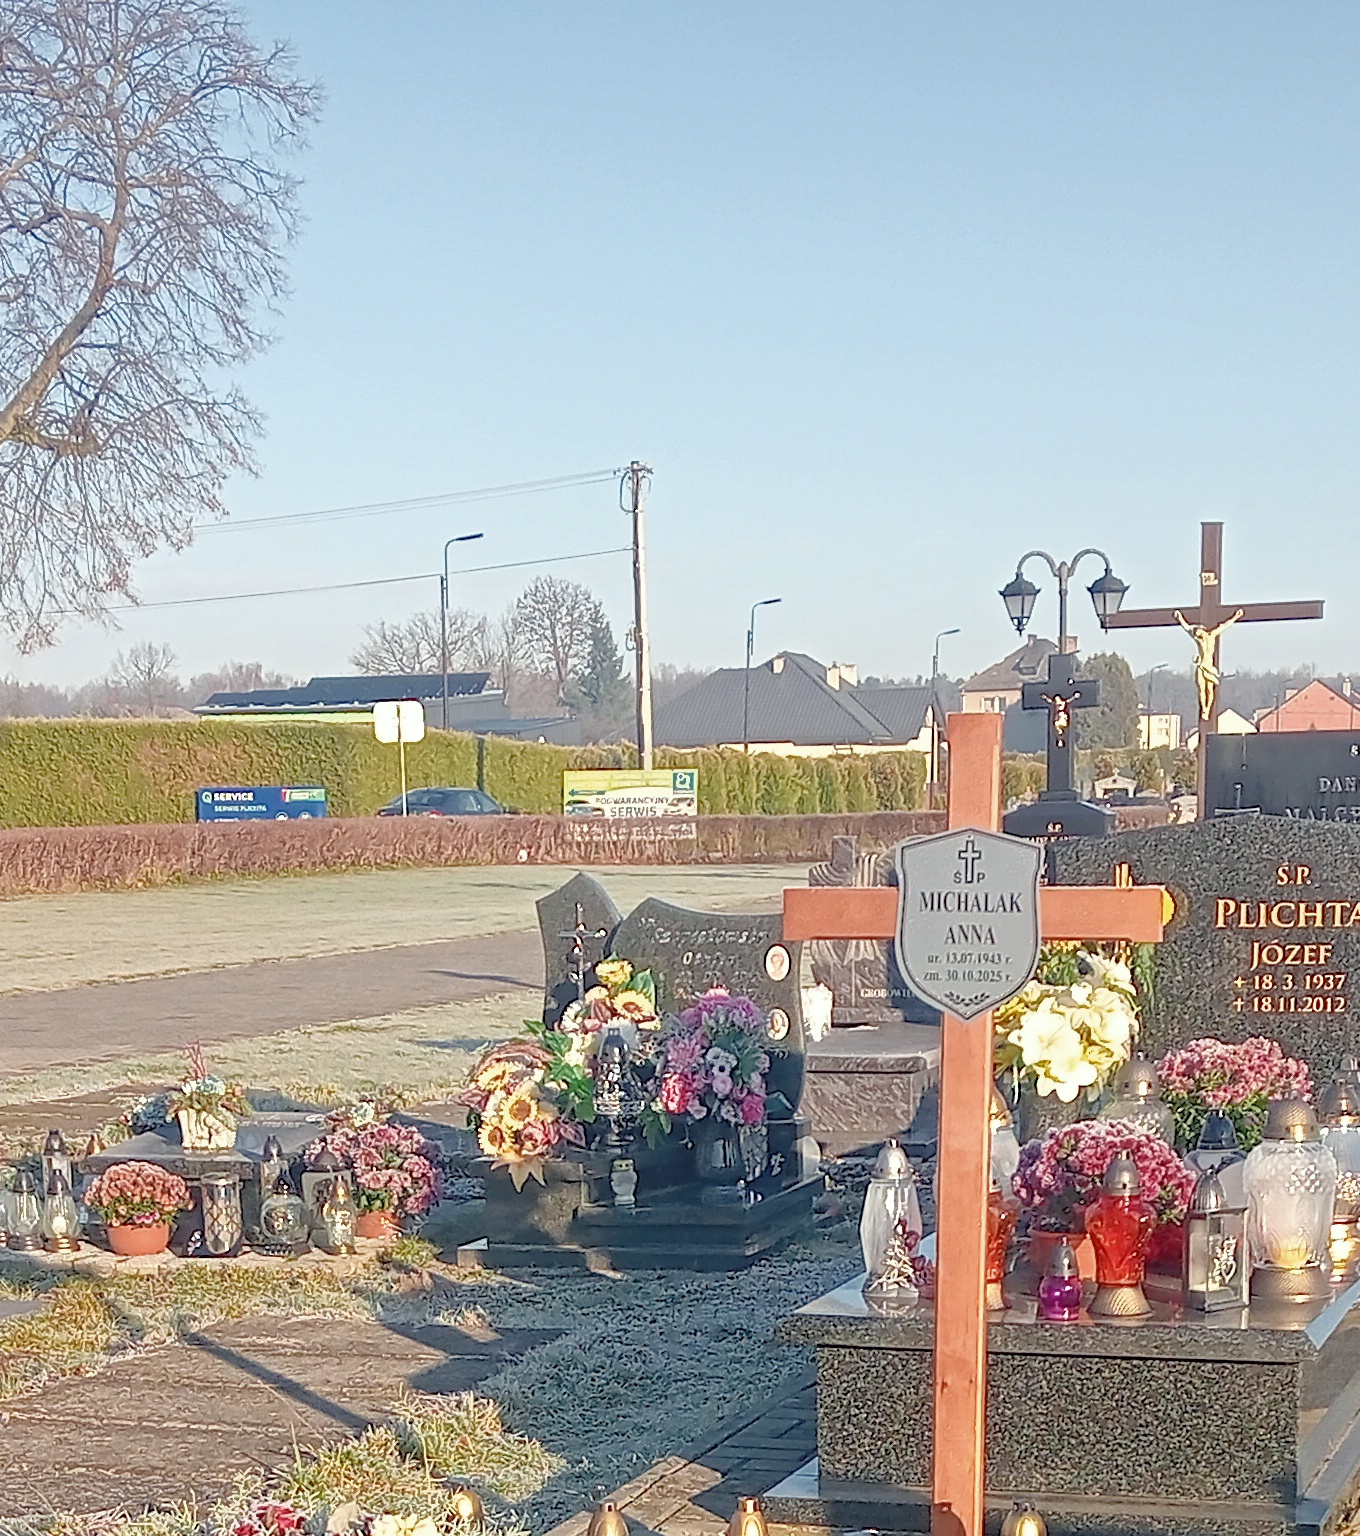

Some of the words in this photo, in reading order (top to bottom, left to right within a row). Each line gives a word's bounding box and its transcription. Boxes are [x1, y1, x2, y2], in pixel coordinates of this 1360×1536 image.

[213, 791, 254, 801] SERVICE
[610, 806, 657, 817] SERWIS
[1275, 860, 1313, 886] Ś.P.
[919, 890, 1023, 914] MICHALAK
[943, 924, 997, 945] ANNA
[1249, 938, 1334, 972] JÓZEF
[1304, 973, 1347, 991] 1937
[1253, 995, 1347, 1013] 18.11.2012
